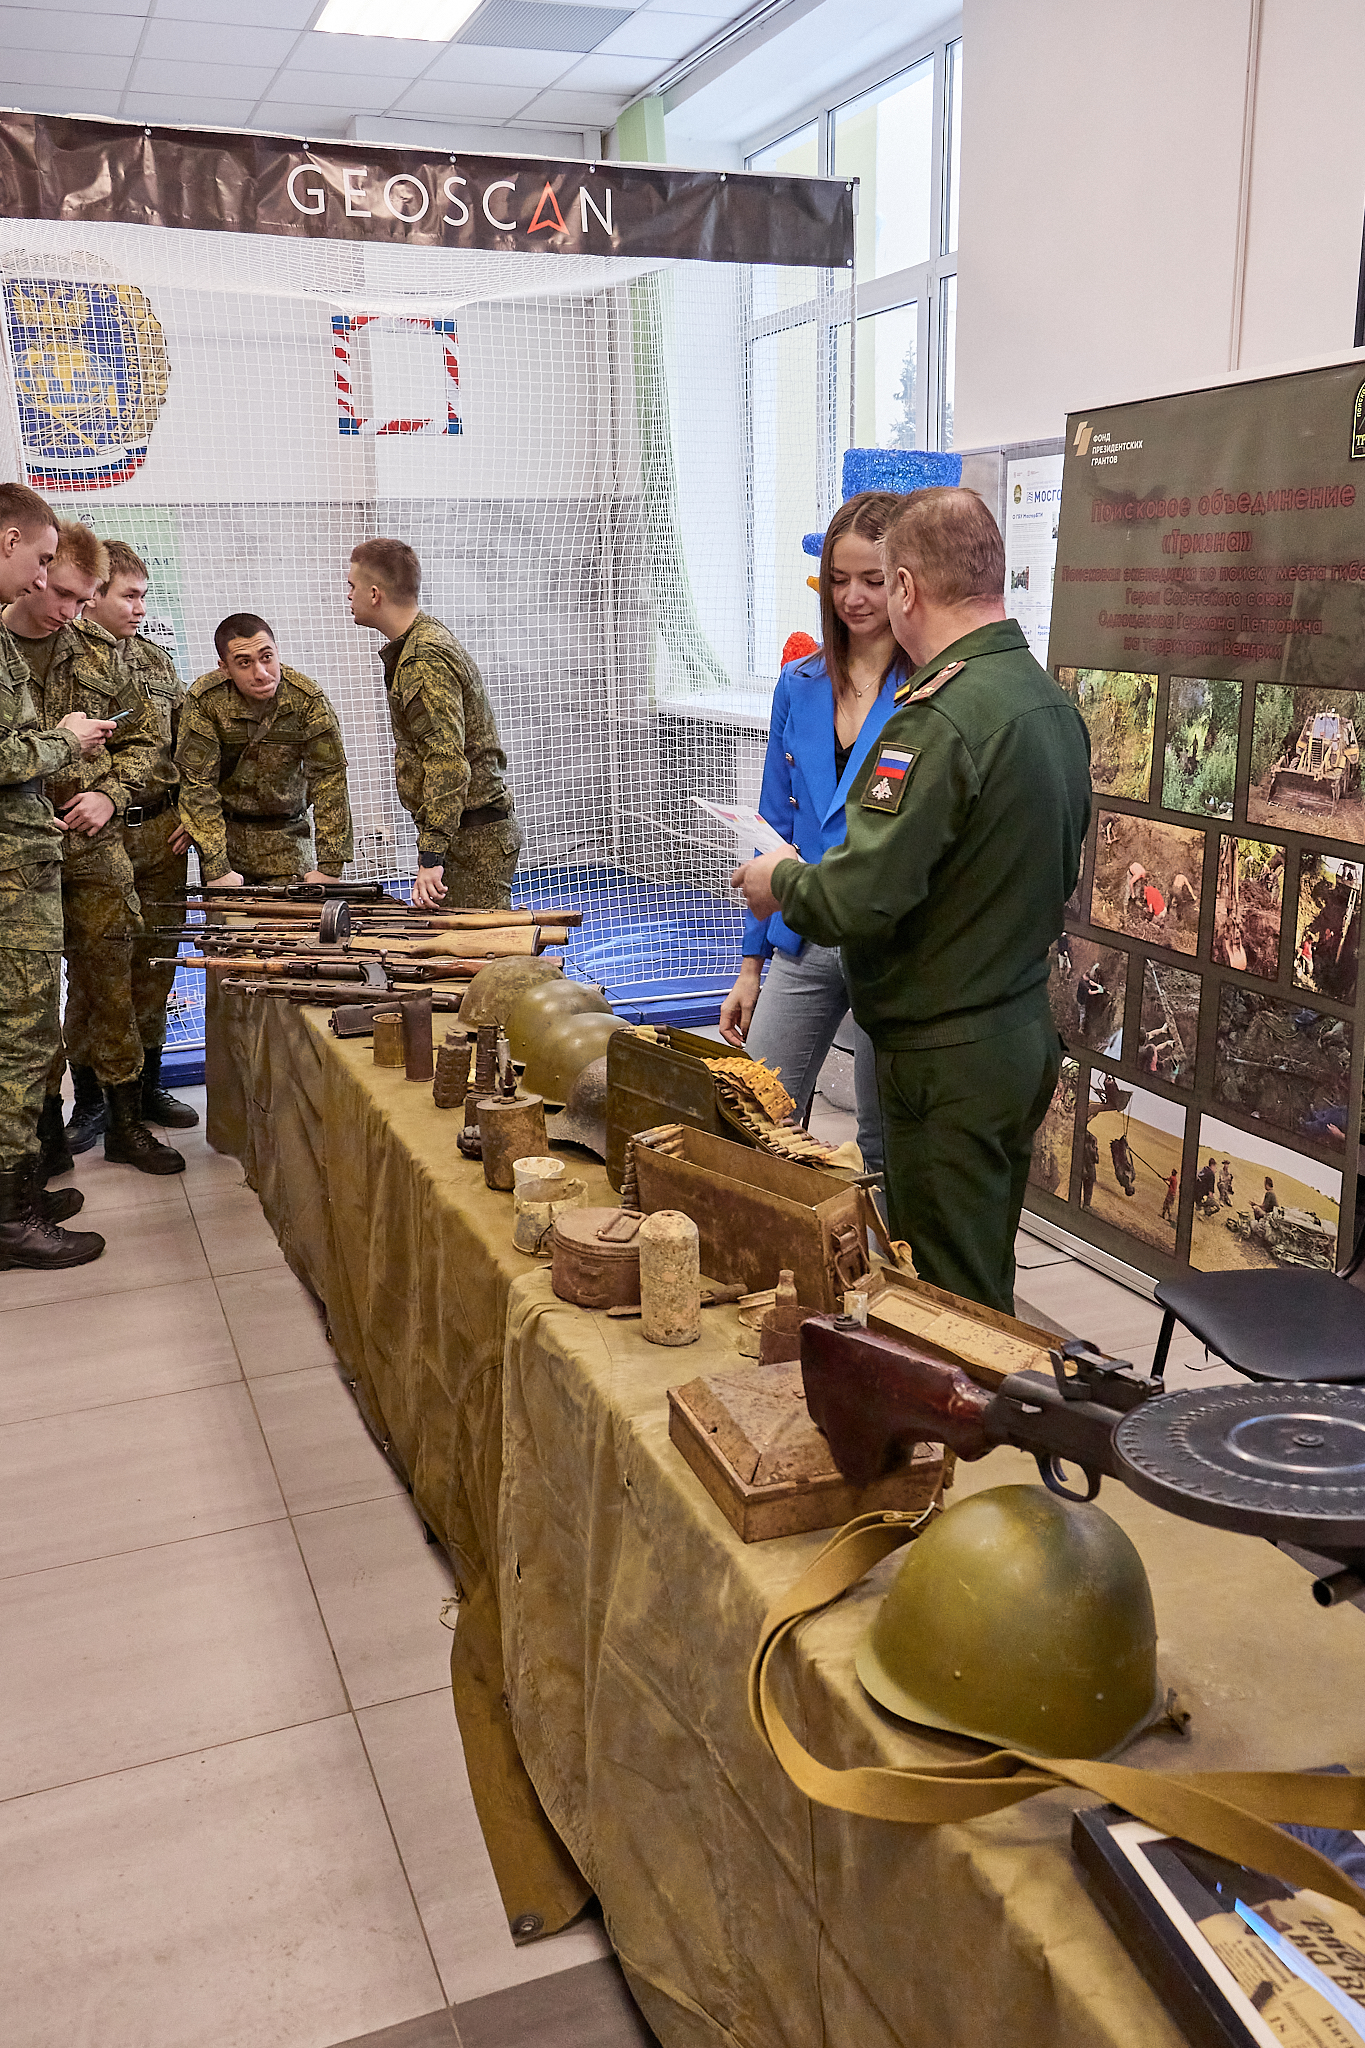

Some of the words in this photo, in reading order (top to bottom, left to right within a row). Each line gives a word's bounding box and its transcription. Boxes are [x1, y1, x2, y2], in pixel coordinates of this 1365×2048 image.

[286, 163, 614, 236] GEOSCAN
[1092, 432, 1111, 443] ФОНД
[1091, 440, 1143, 455] ПРЕЗИДЕНТСКИХ
[1090, 456, 1118, 466] ГРАНТОВ
[1091, 497, 1192, 523] Поисковое
[1198, 484, 1356, 516] объединение
[1277, 566, 1327, 581] места
[1163, 588, 1241, 607] Советского
[1246, 592, 1294, 607] союза
[1240, 613, 1323, 637] Петровича
[1123, 636, 1140, 651] на
[1222, 638, 1285, 662] Венгрии
